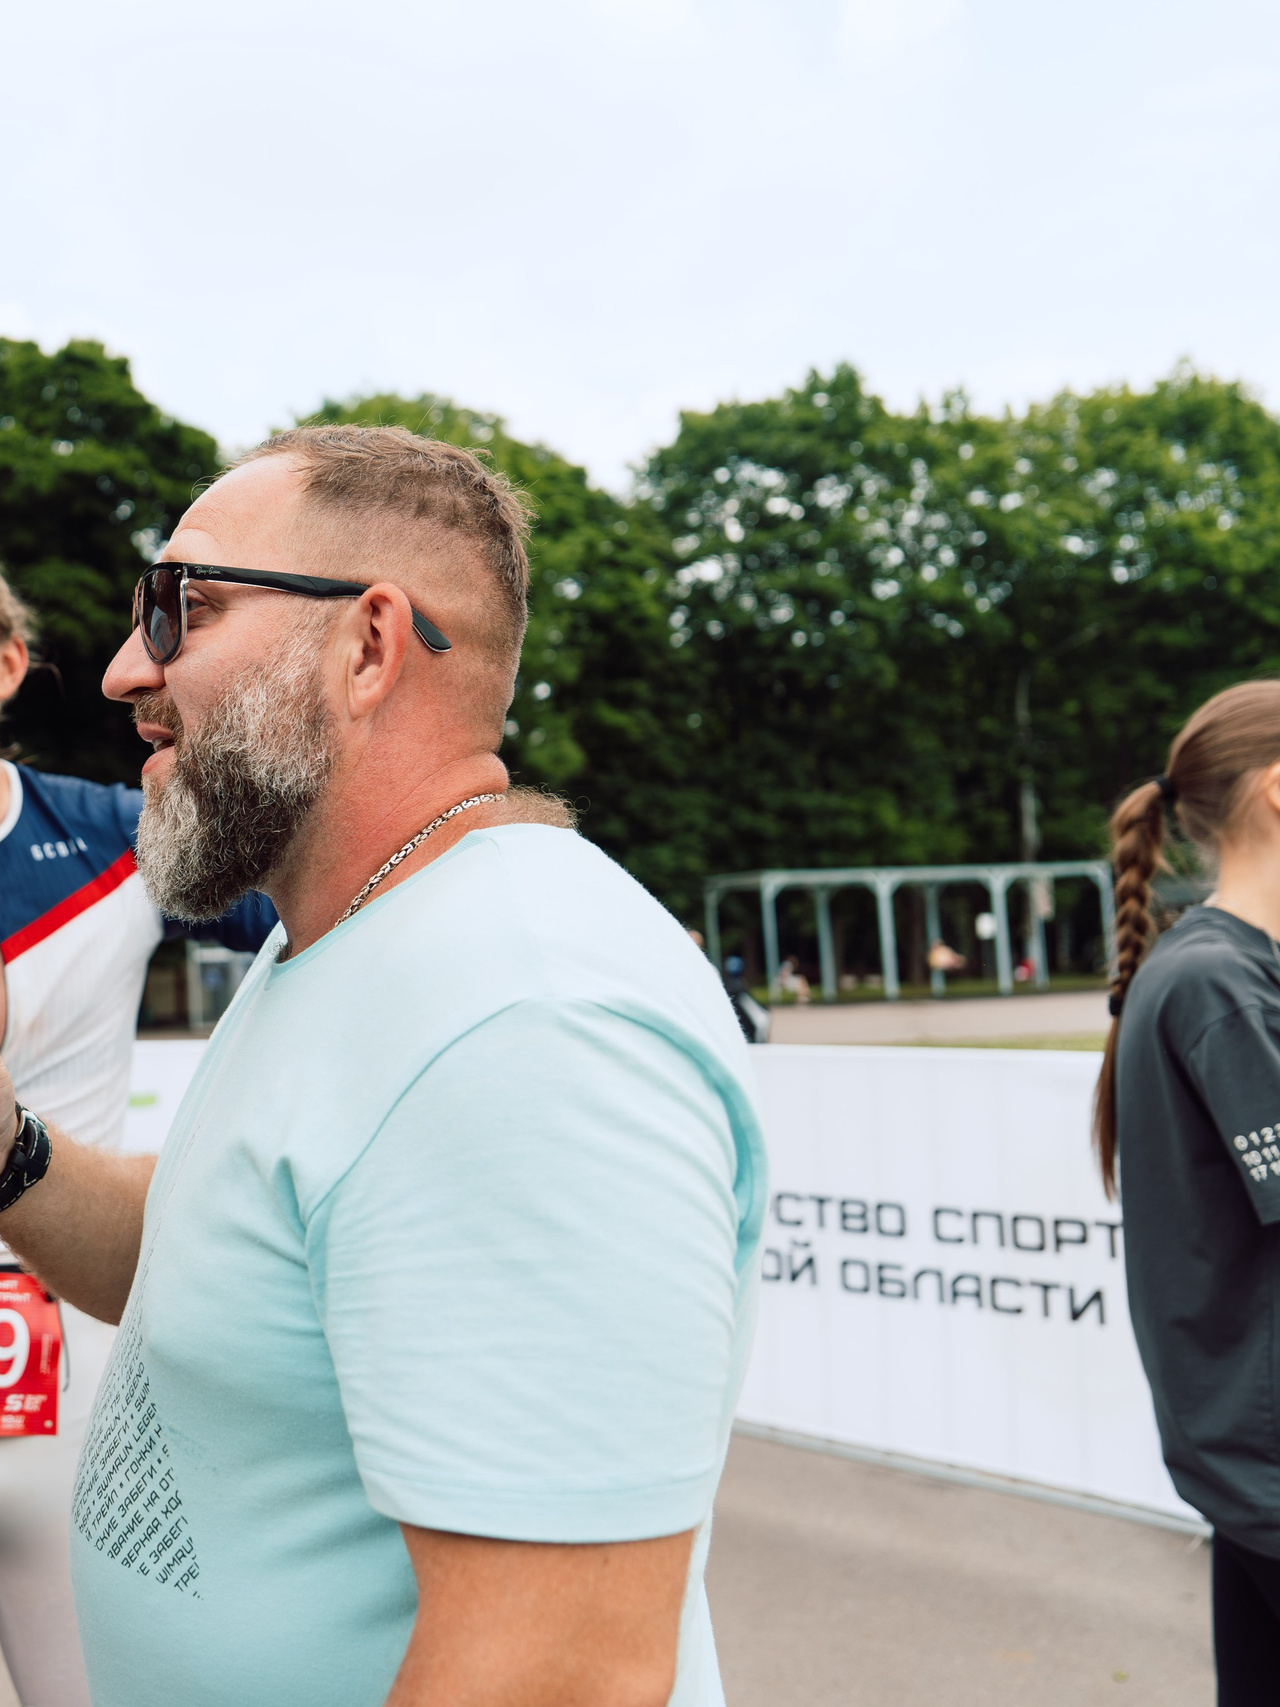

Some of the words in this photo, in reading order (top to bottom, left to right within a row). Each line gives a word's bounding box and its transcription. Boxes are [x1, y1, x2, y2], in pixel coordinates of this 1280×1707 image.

[774, 1191, 907, 1238] СТВО
[932, 1206, 1124, 1260] СПОРТ
[762, 1238, 818, 1286] ОЙ
[840, 1258, 1107, 1325] ОБЛАСТИ
[121, 1361, 145, 1413] LEGEND
[97, 1441, 133, 1499] SWIMRUN
[100, 1420, 130, 1471] ЗАБЕГИ
[91, 1488, 119, 1530] ТРЕЙЛ
[124, 1436, 157, 1482] ГОНКИ
[94, 1516, 119, 1551] СКИЕ
[117, 1464, 158, 1518] ЗАБЕГИ
[142, 1490, 160, 1513] НА
[159, 1466, 174, 1492] ОТ
[136, 1562, 151, 1576] Е
[155, 1536, 194, 1584] WIMRU
